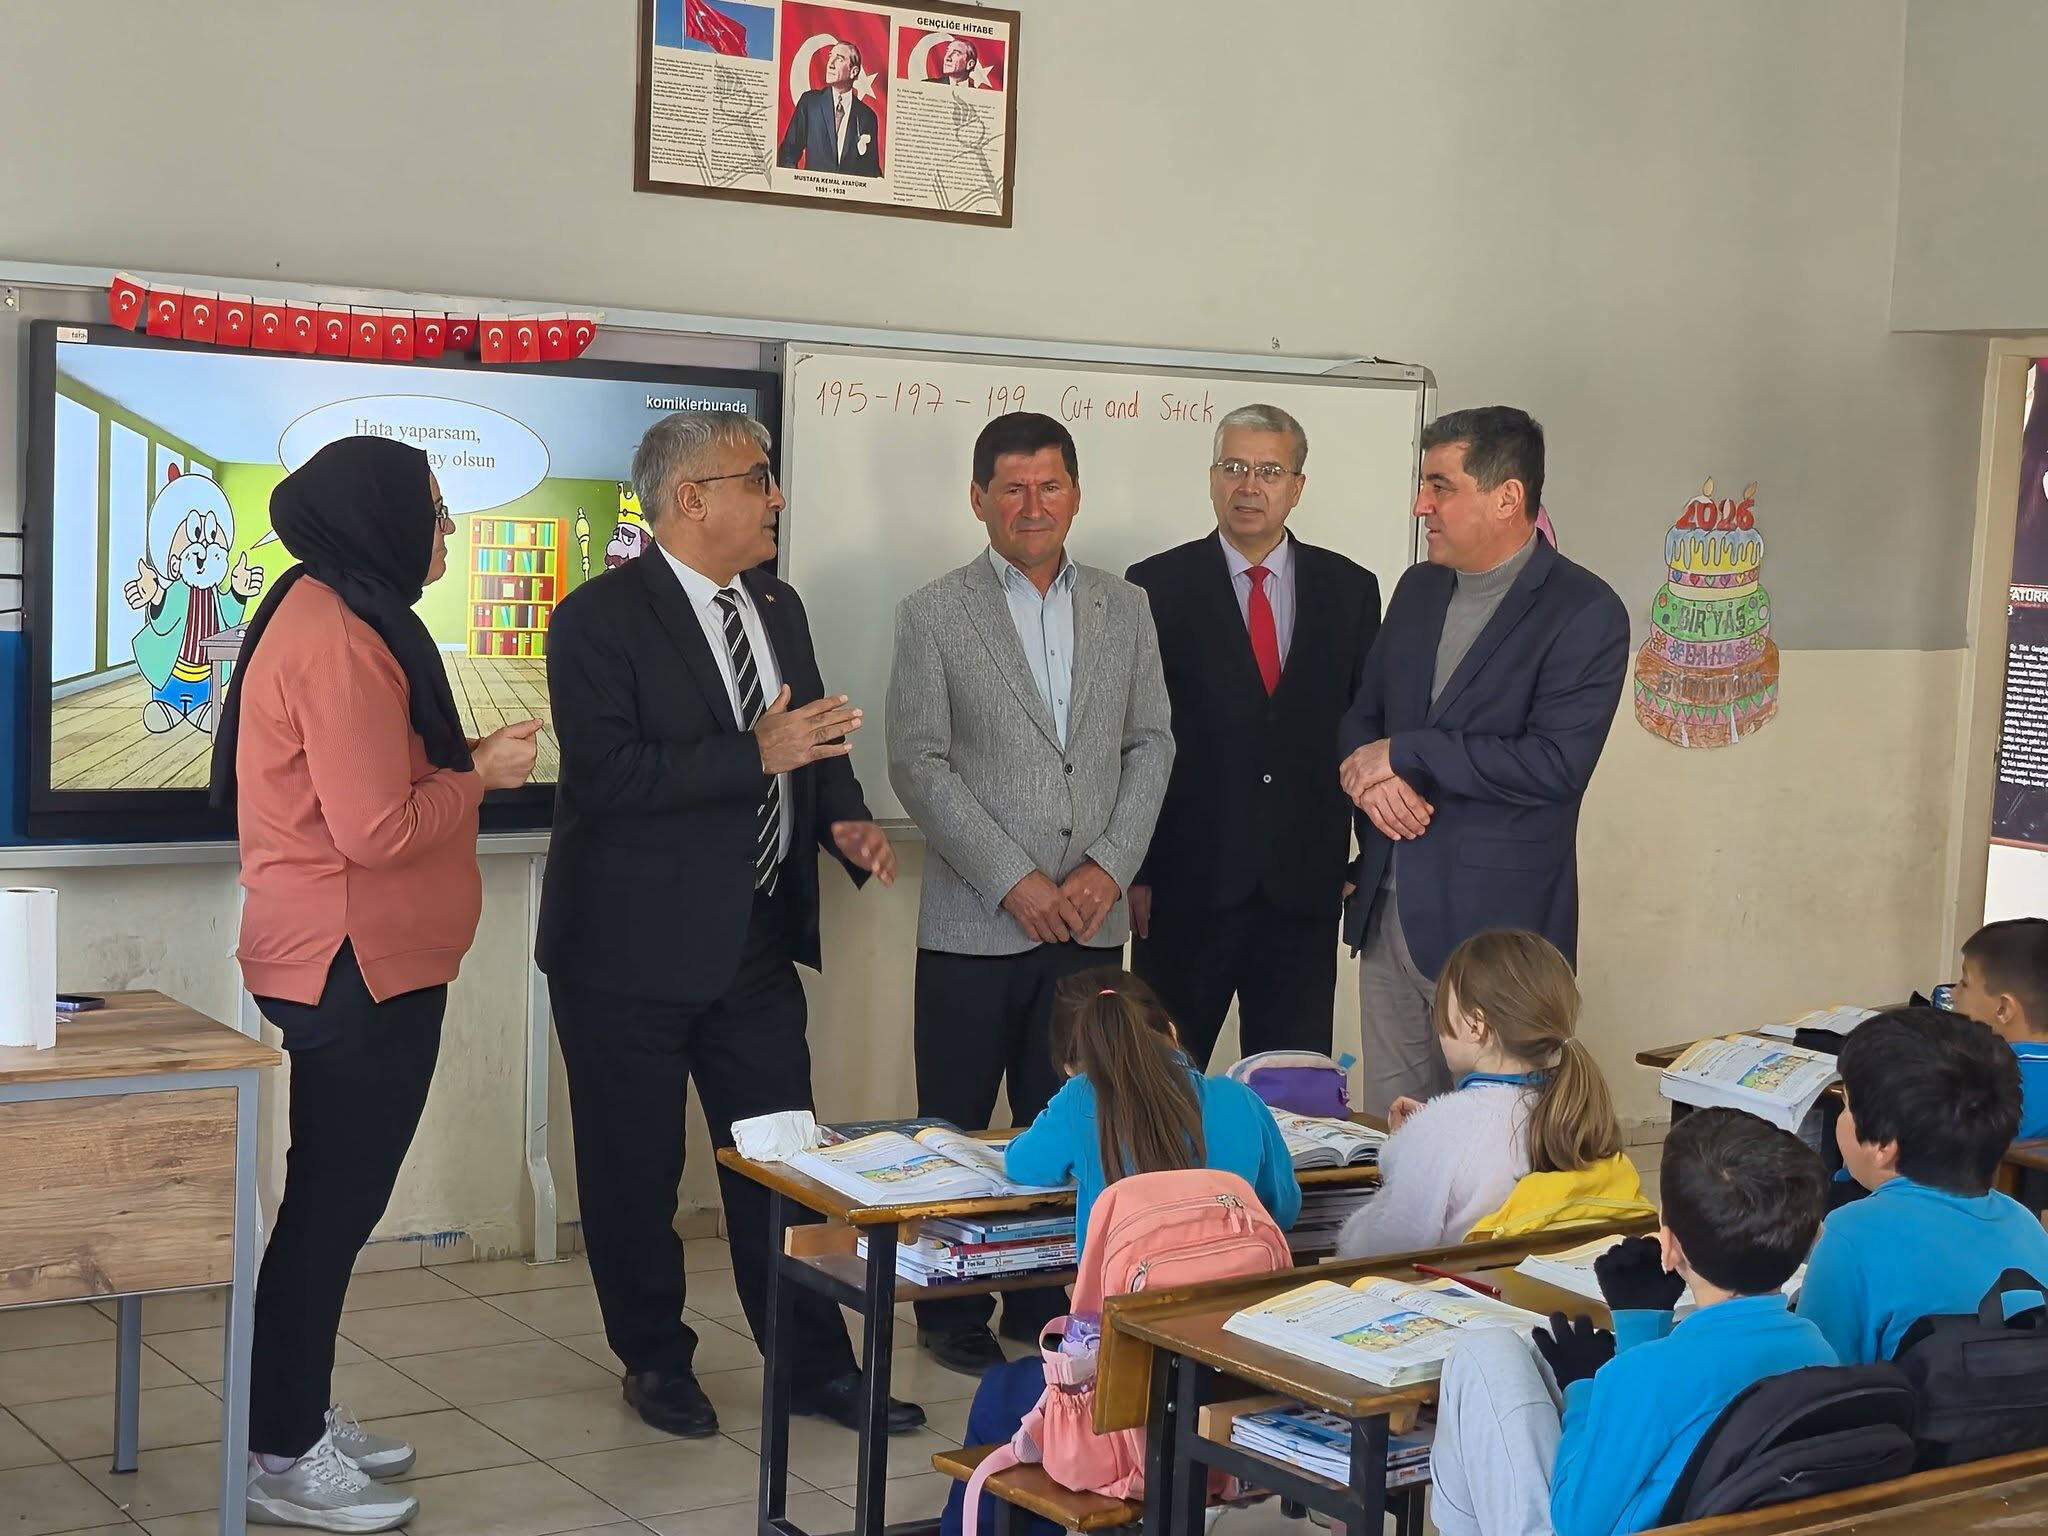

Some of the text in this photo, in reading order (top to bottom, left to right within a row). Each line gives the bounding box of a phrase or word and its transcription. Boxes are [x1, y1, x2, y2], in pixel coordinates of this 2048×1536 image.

[917, 17, 994, 35] GENÇLİĞE HİTABE
[794, 175, 867, 188] MUSTAFA KEMAL ATATÜRK
[646, 394, 748, 414] komiklerburada
[1060, 385, 1094, 422] Cut
[1105, 390, 1139, 419] and
[1160, 390, 1214, 424] Stick
[355, 418, 481, 444] Hata yaparsam,
[452, 450, 496, 468] olsun
[1675, 497, 1755, 531] 2026
